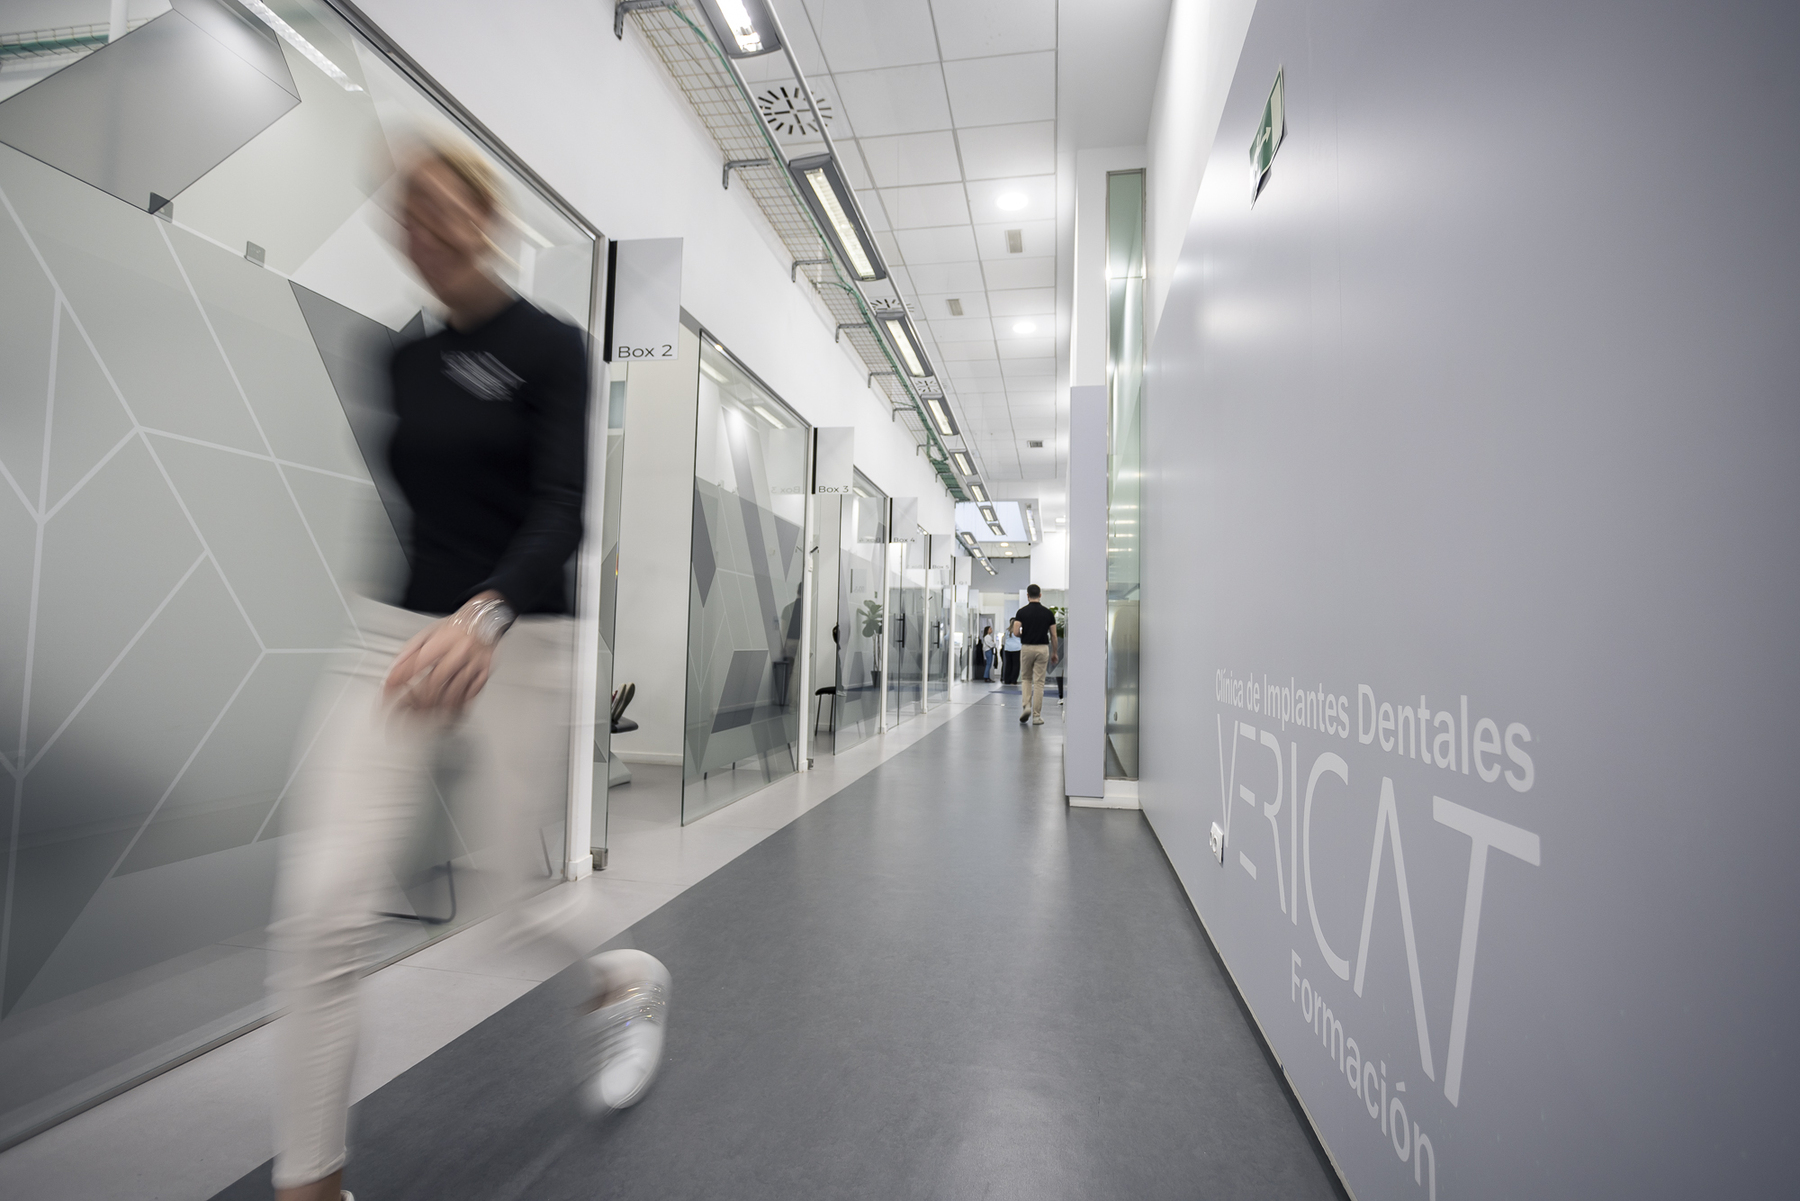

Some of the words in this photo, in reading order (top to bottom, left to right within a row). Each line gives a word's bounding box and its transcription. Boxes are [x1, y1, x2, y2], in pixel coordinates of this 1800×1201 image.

[618, 346, 655, 358] Box
[661, 344, 673, 357] 2
[818, 485, 840, 494] Box
[842, 485, 849, 494] 3
[1215, 668, 1244, 709] Clínica
[1246, 672, 1260, 713] de
[1264, 674, 1350, 739] Implantes
[1358, 683, 1535, 792] Dentales
[1217, 713, 1541, 1108] VERICAT
[1291, 948, 1436, 1201] Formación
